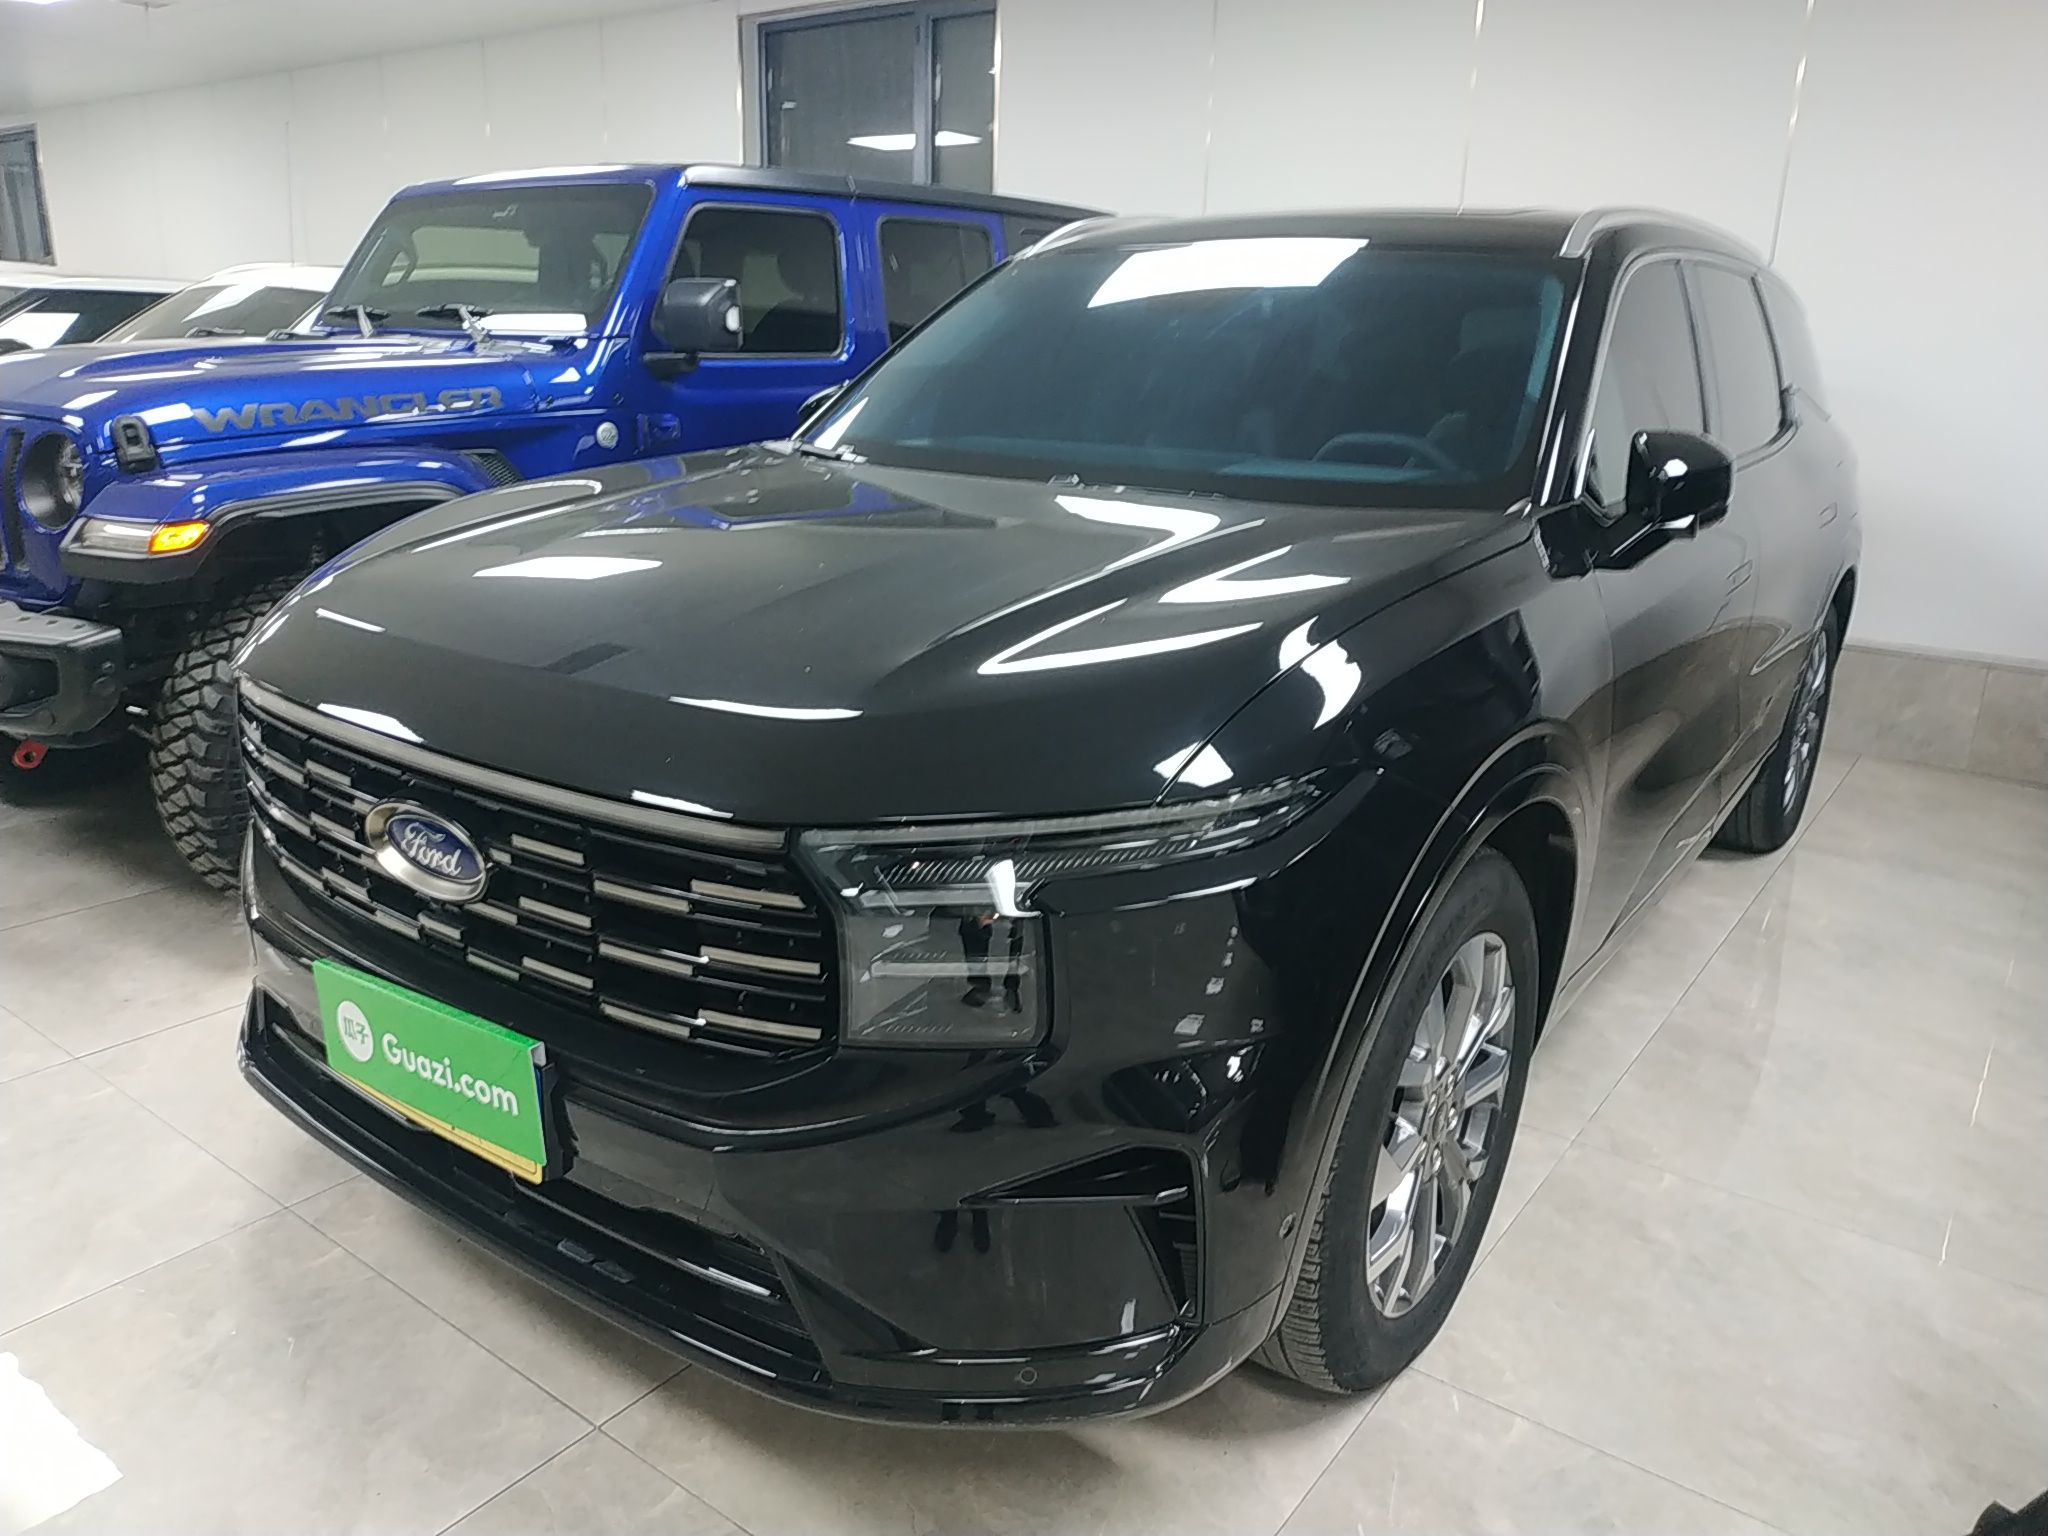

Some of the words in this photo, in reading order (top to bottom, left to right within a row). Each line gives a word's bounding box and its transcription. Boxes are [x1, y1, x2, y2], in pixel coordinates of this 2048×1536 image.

[192, 385, 504, 432] WRANGLER
[400, 821, 462, 876] Ford
[343, 1015, 369, 1045] 瓜子
[381, 1032, 519, 1117] Guazi.com
